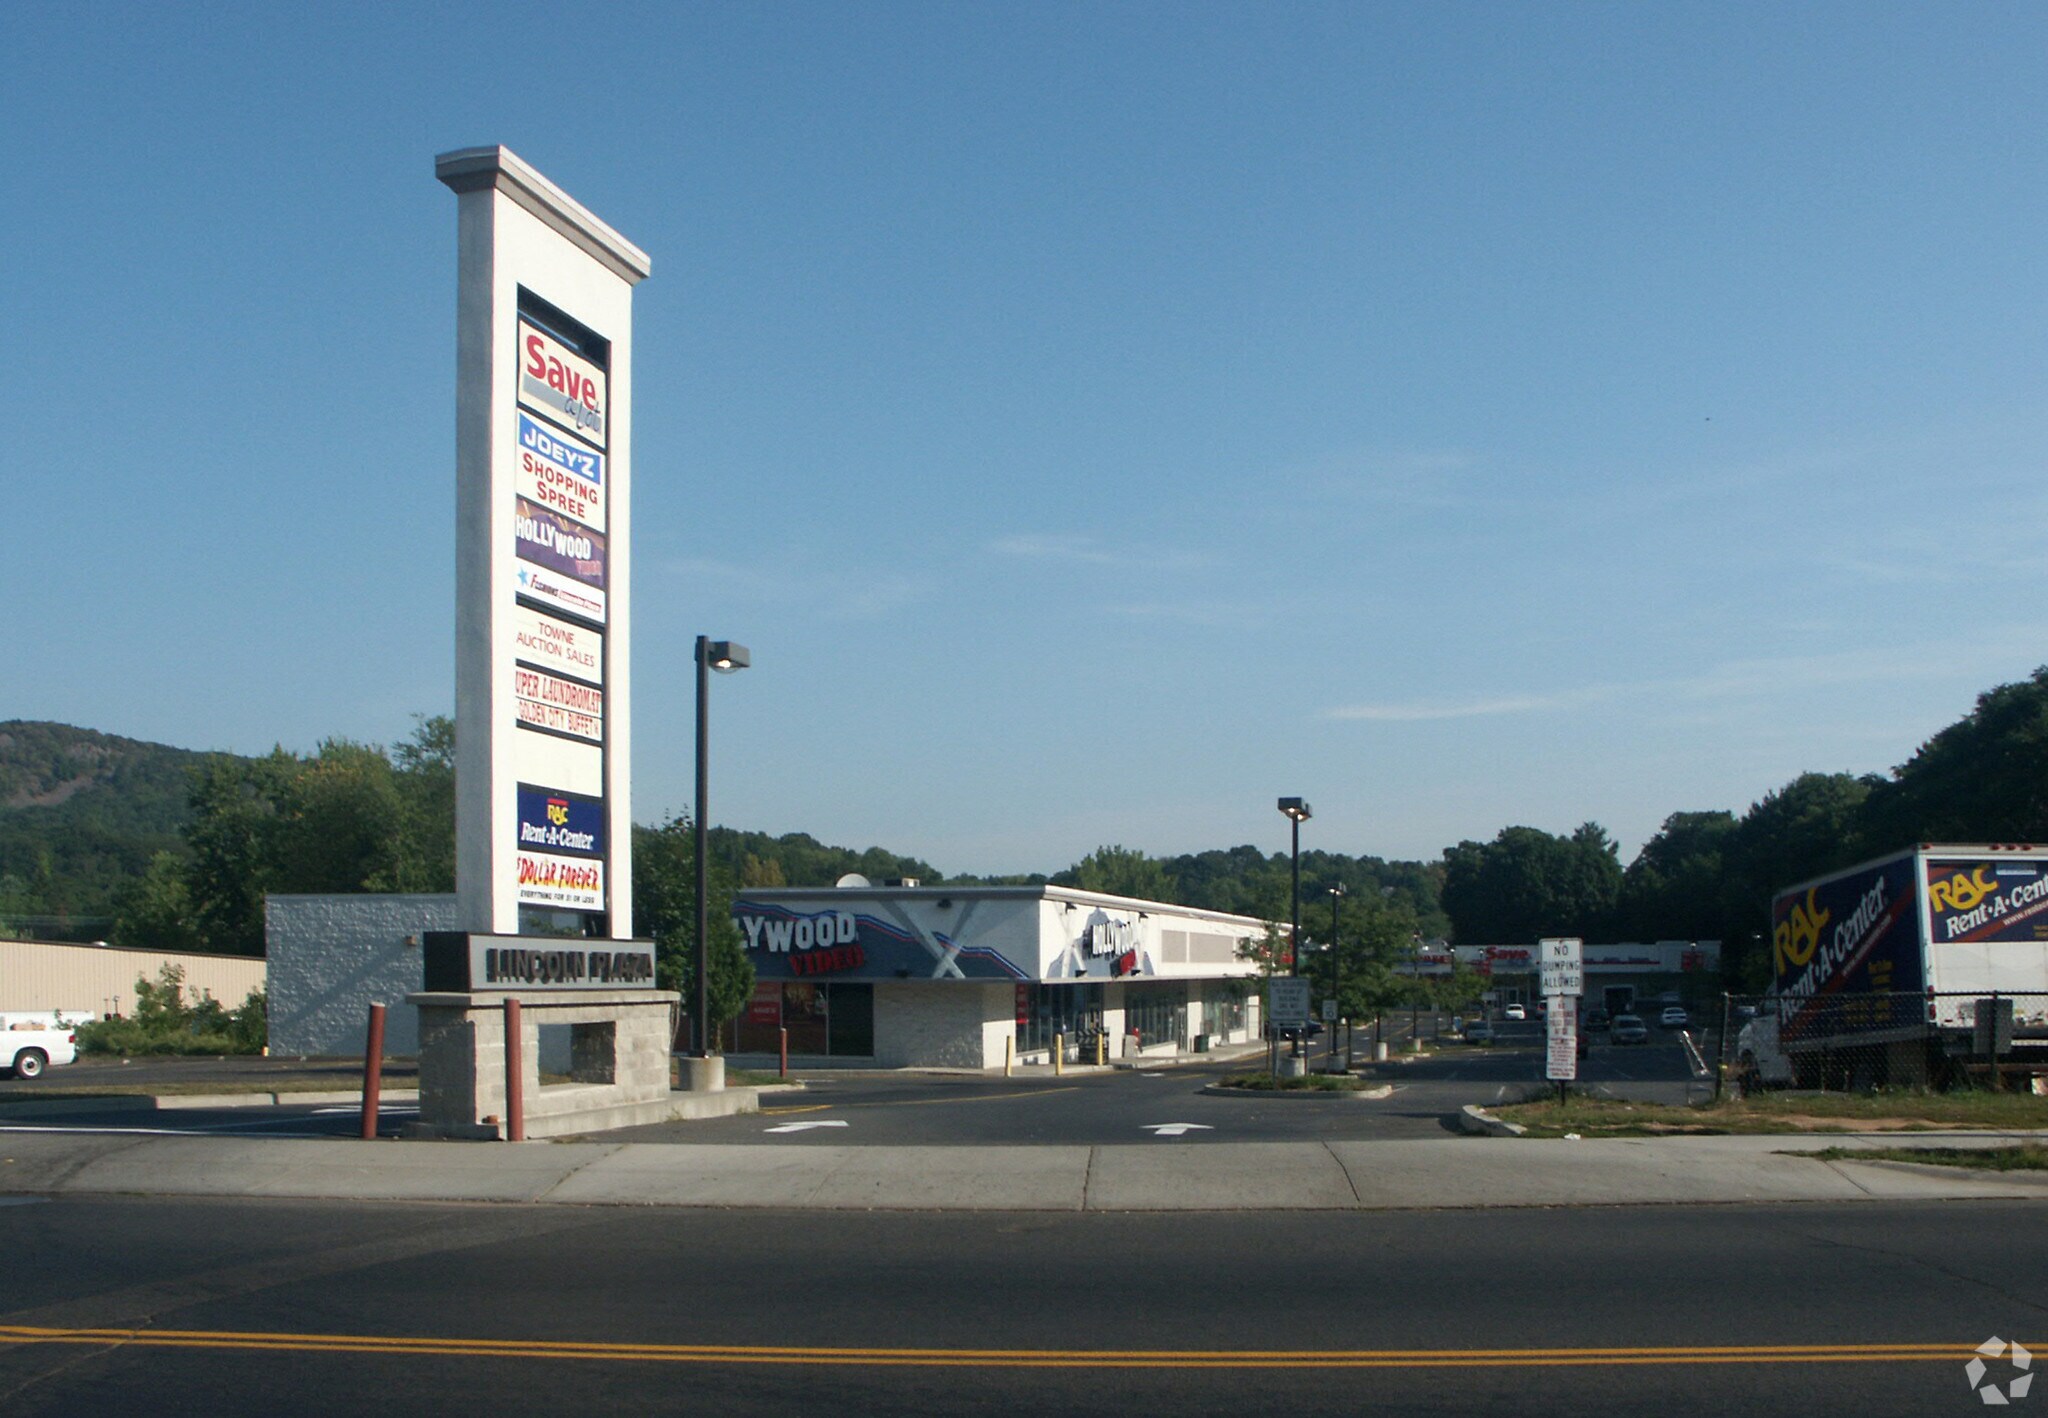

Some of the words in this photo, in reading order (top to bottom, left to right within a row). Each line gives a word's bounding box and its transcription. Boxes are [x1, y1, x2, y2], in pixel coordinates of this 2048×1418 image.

[526, 334, 597, 411] Save
[524, 428, 595, 479] JOEY'Z
[522, 452, 598, 505] SHOPPING
[536, 480, 586, 519] SPREE
[516, 514, 592, 561] HOLLYWOOD
[516, 631, 562, 657] AUCTION
[566, 647, 595, 668] SALES
[539, 621, 575, 645] TOWNE
[1928, 863, 1999, 914] RAC
[732, 911, 857, 953] YWOOD
[1553, 945, 1569, 956] NO
[1775, 886, 1832, 976] RAC
[788, 944, 865, 977] VIDEO
[1542, 960, 1580, 972] DUMPING
[1543, 976, 1580, 988] ALLOWED
